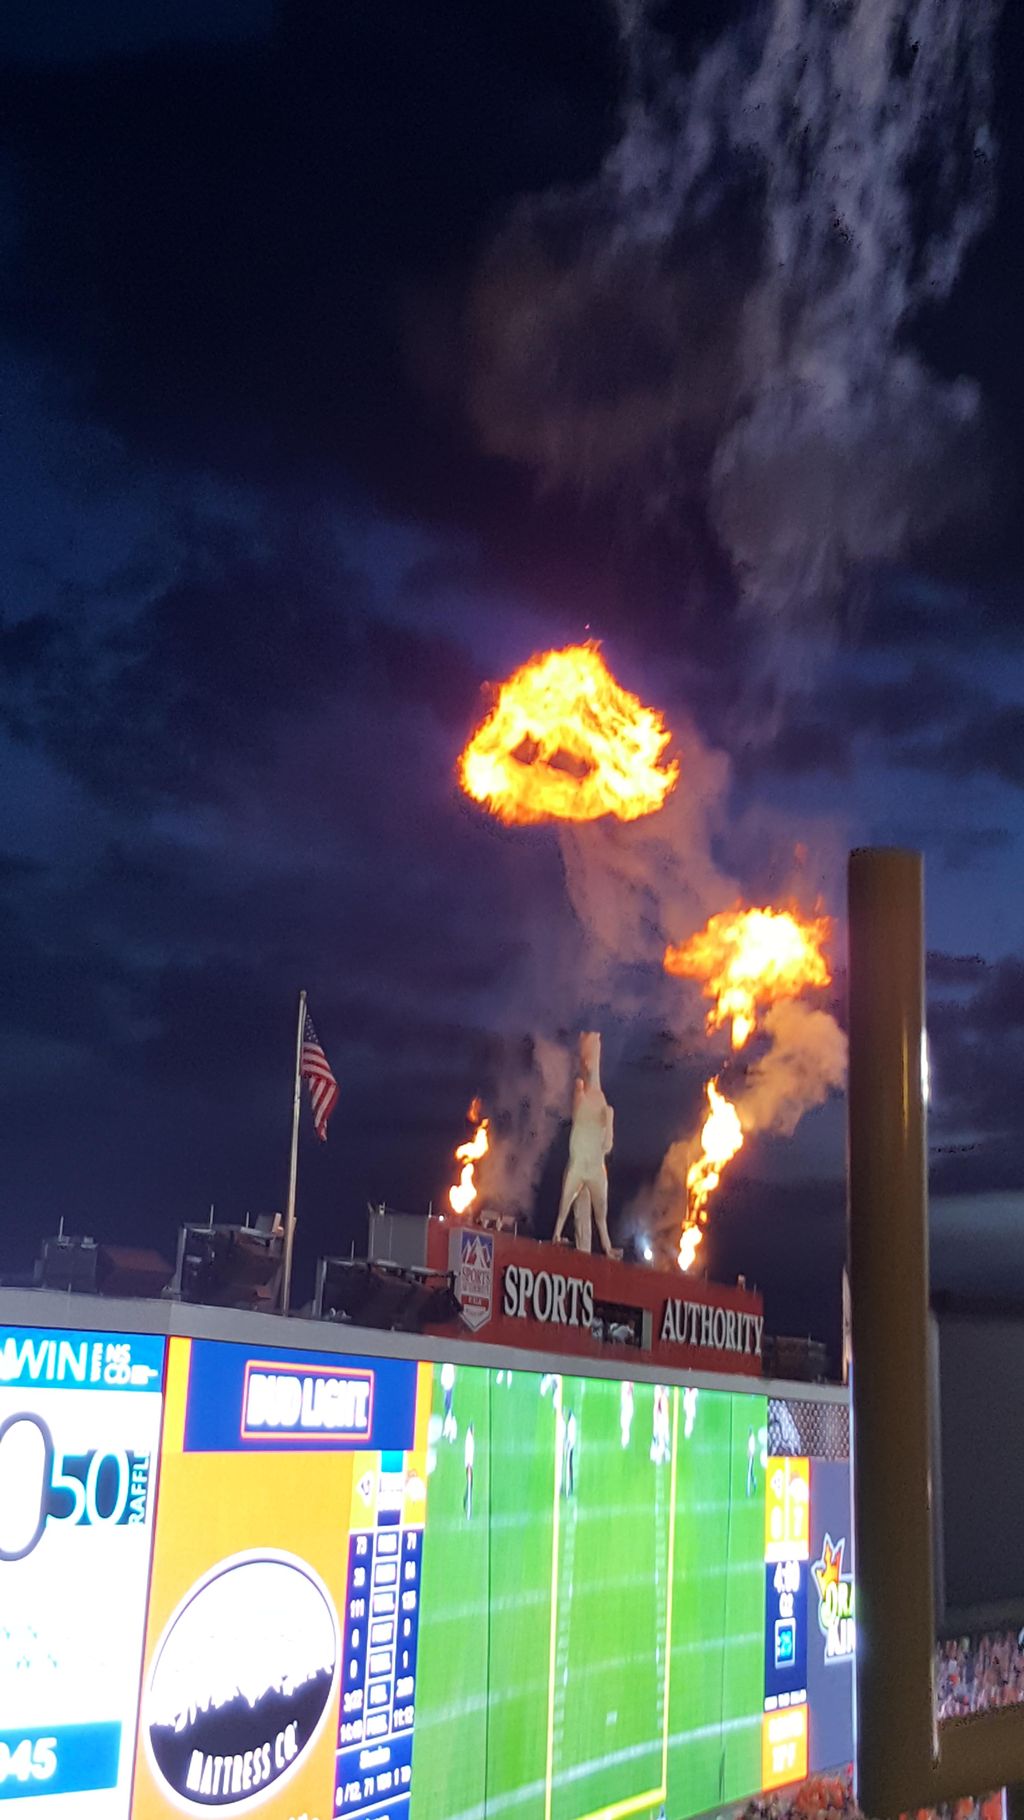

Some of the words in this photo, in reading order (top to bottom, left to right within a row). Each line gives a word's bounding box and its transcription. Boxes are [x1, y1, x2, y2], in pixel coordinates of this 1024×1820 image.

[503, 1264, 594, 1327] SPORTS
[661, 1297, 764, 1355] AUTHORITY
[6, 1337, 88, 1381] WIN
[46, 1447, 130, 1526] 50
[186, 1742, 271, 1796] MATTRESS
